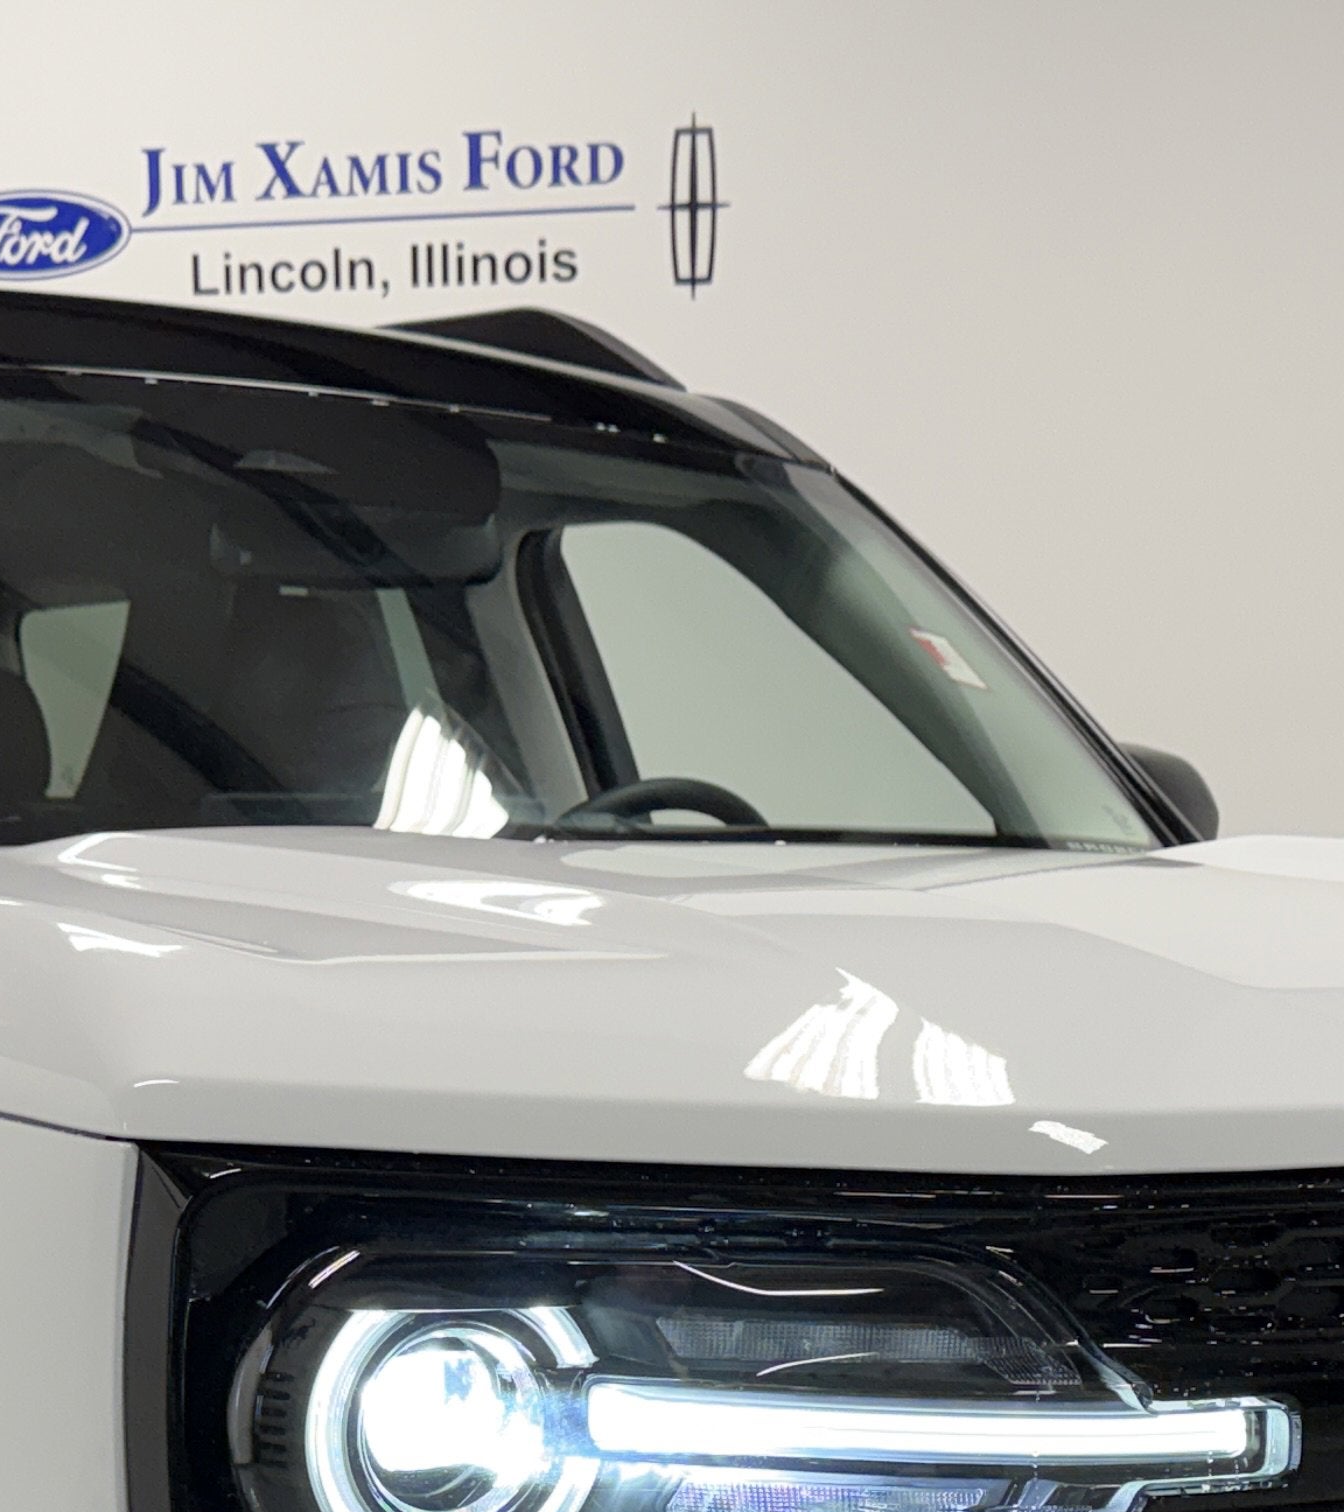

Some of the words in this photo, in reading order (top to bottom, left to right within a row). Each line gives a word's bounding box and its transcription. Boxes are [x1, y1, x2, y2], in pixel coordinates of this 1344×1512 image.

[141, 148, 236, 217] JIM
[255, 140, 444, 201] XAMIS
[462, 129, 625, 193] FORD
[189, 246, 391, 298] Lincoln,
[410, 239, 579, 290] Illinois
